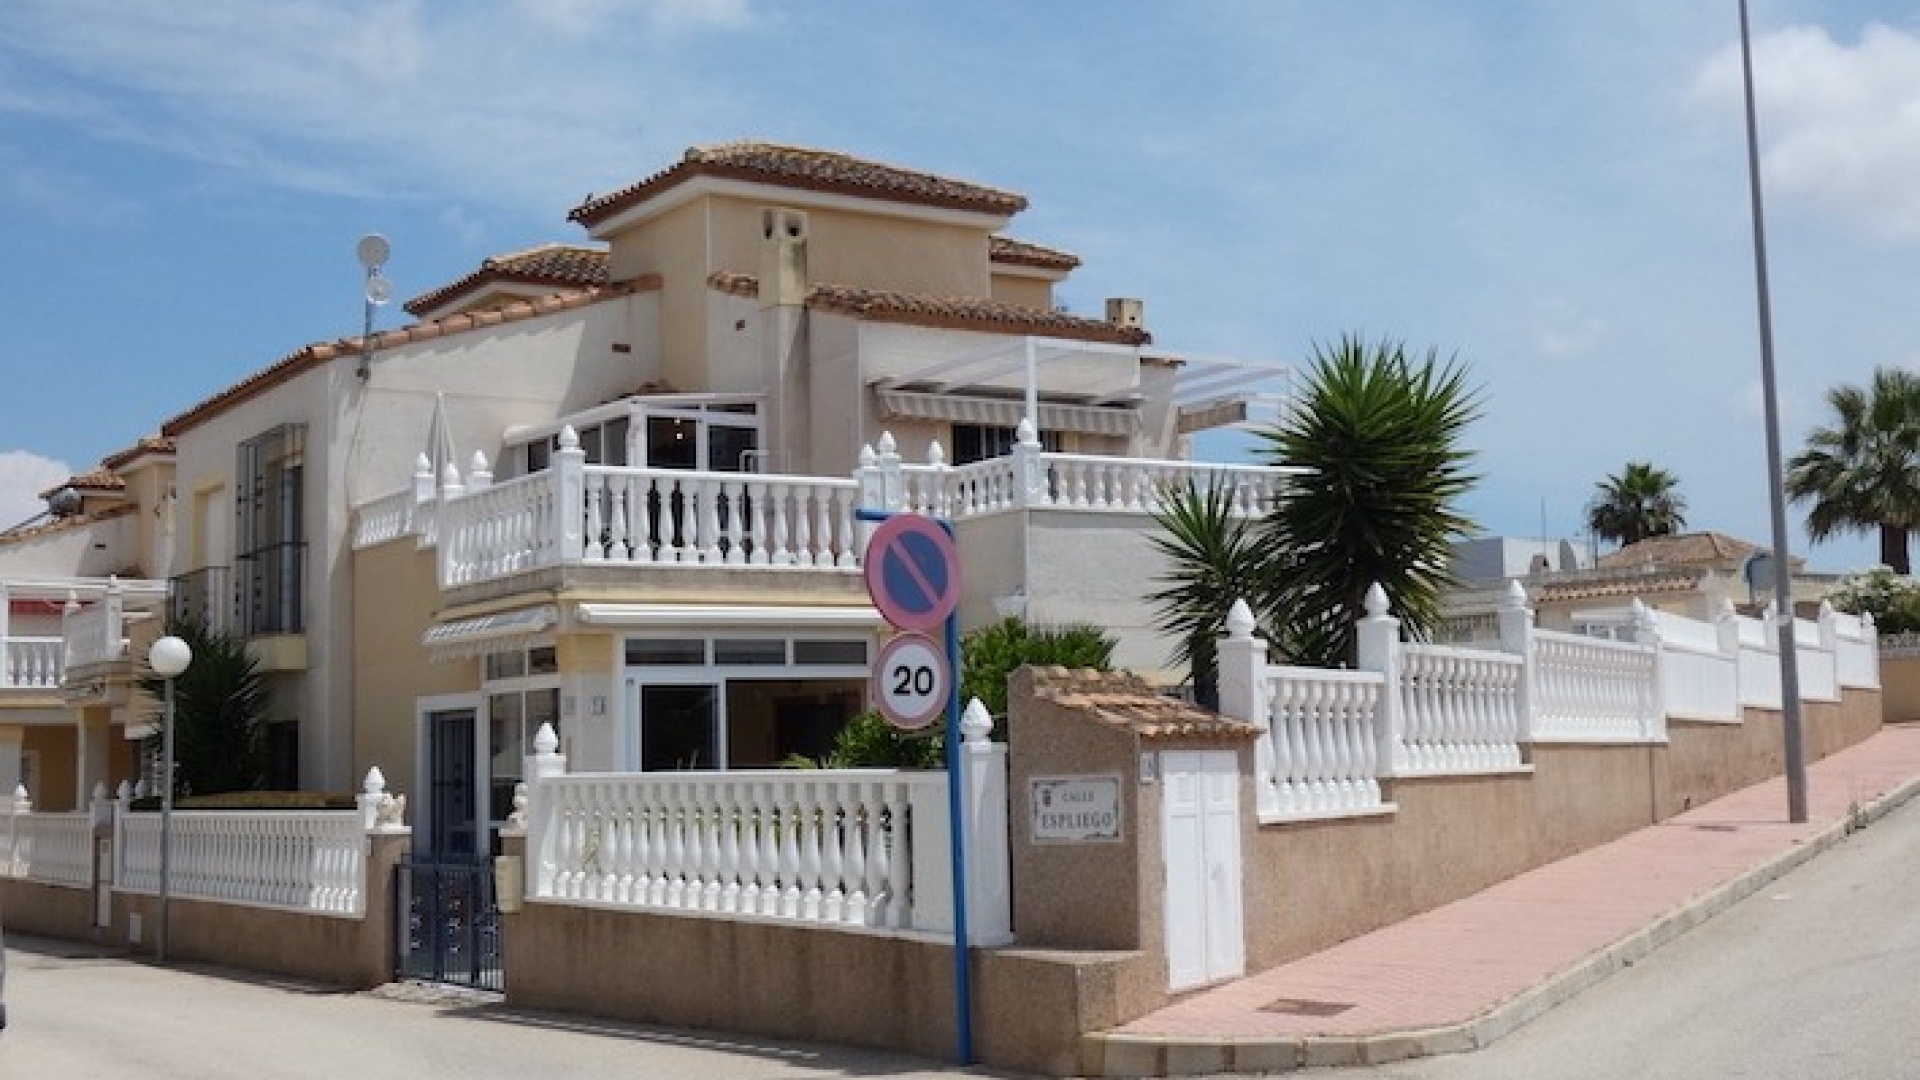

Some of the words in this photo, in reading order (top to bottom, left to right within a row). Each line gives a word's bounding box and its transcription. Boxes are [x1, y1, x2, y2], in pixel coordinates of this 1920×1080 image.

[893, 666, 934, 696] 20
[1061, 790, 1095, 803] CALLE
[1041, 813, 1112, 829] ESPLIEGO
